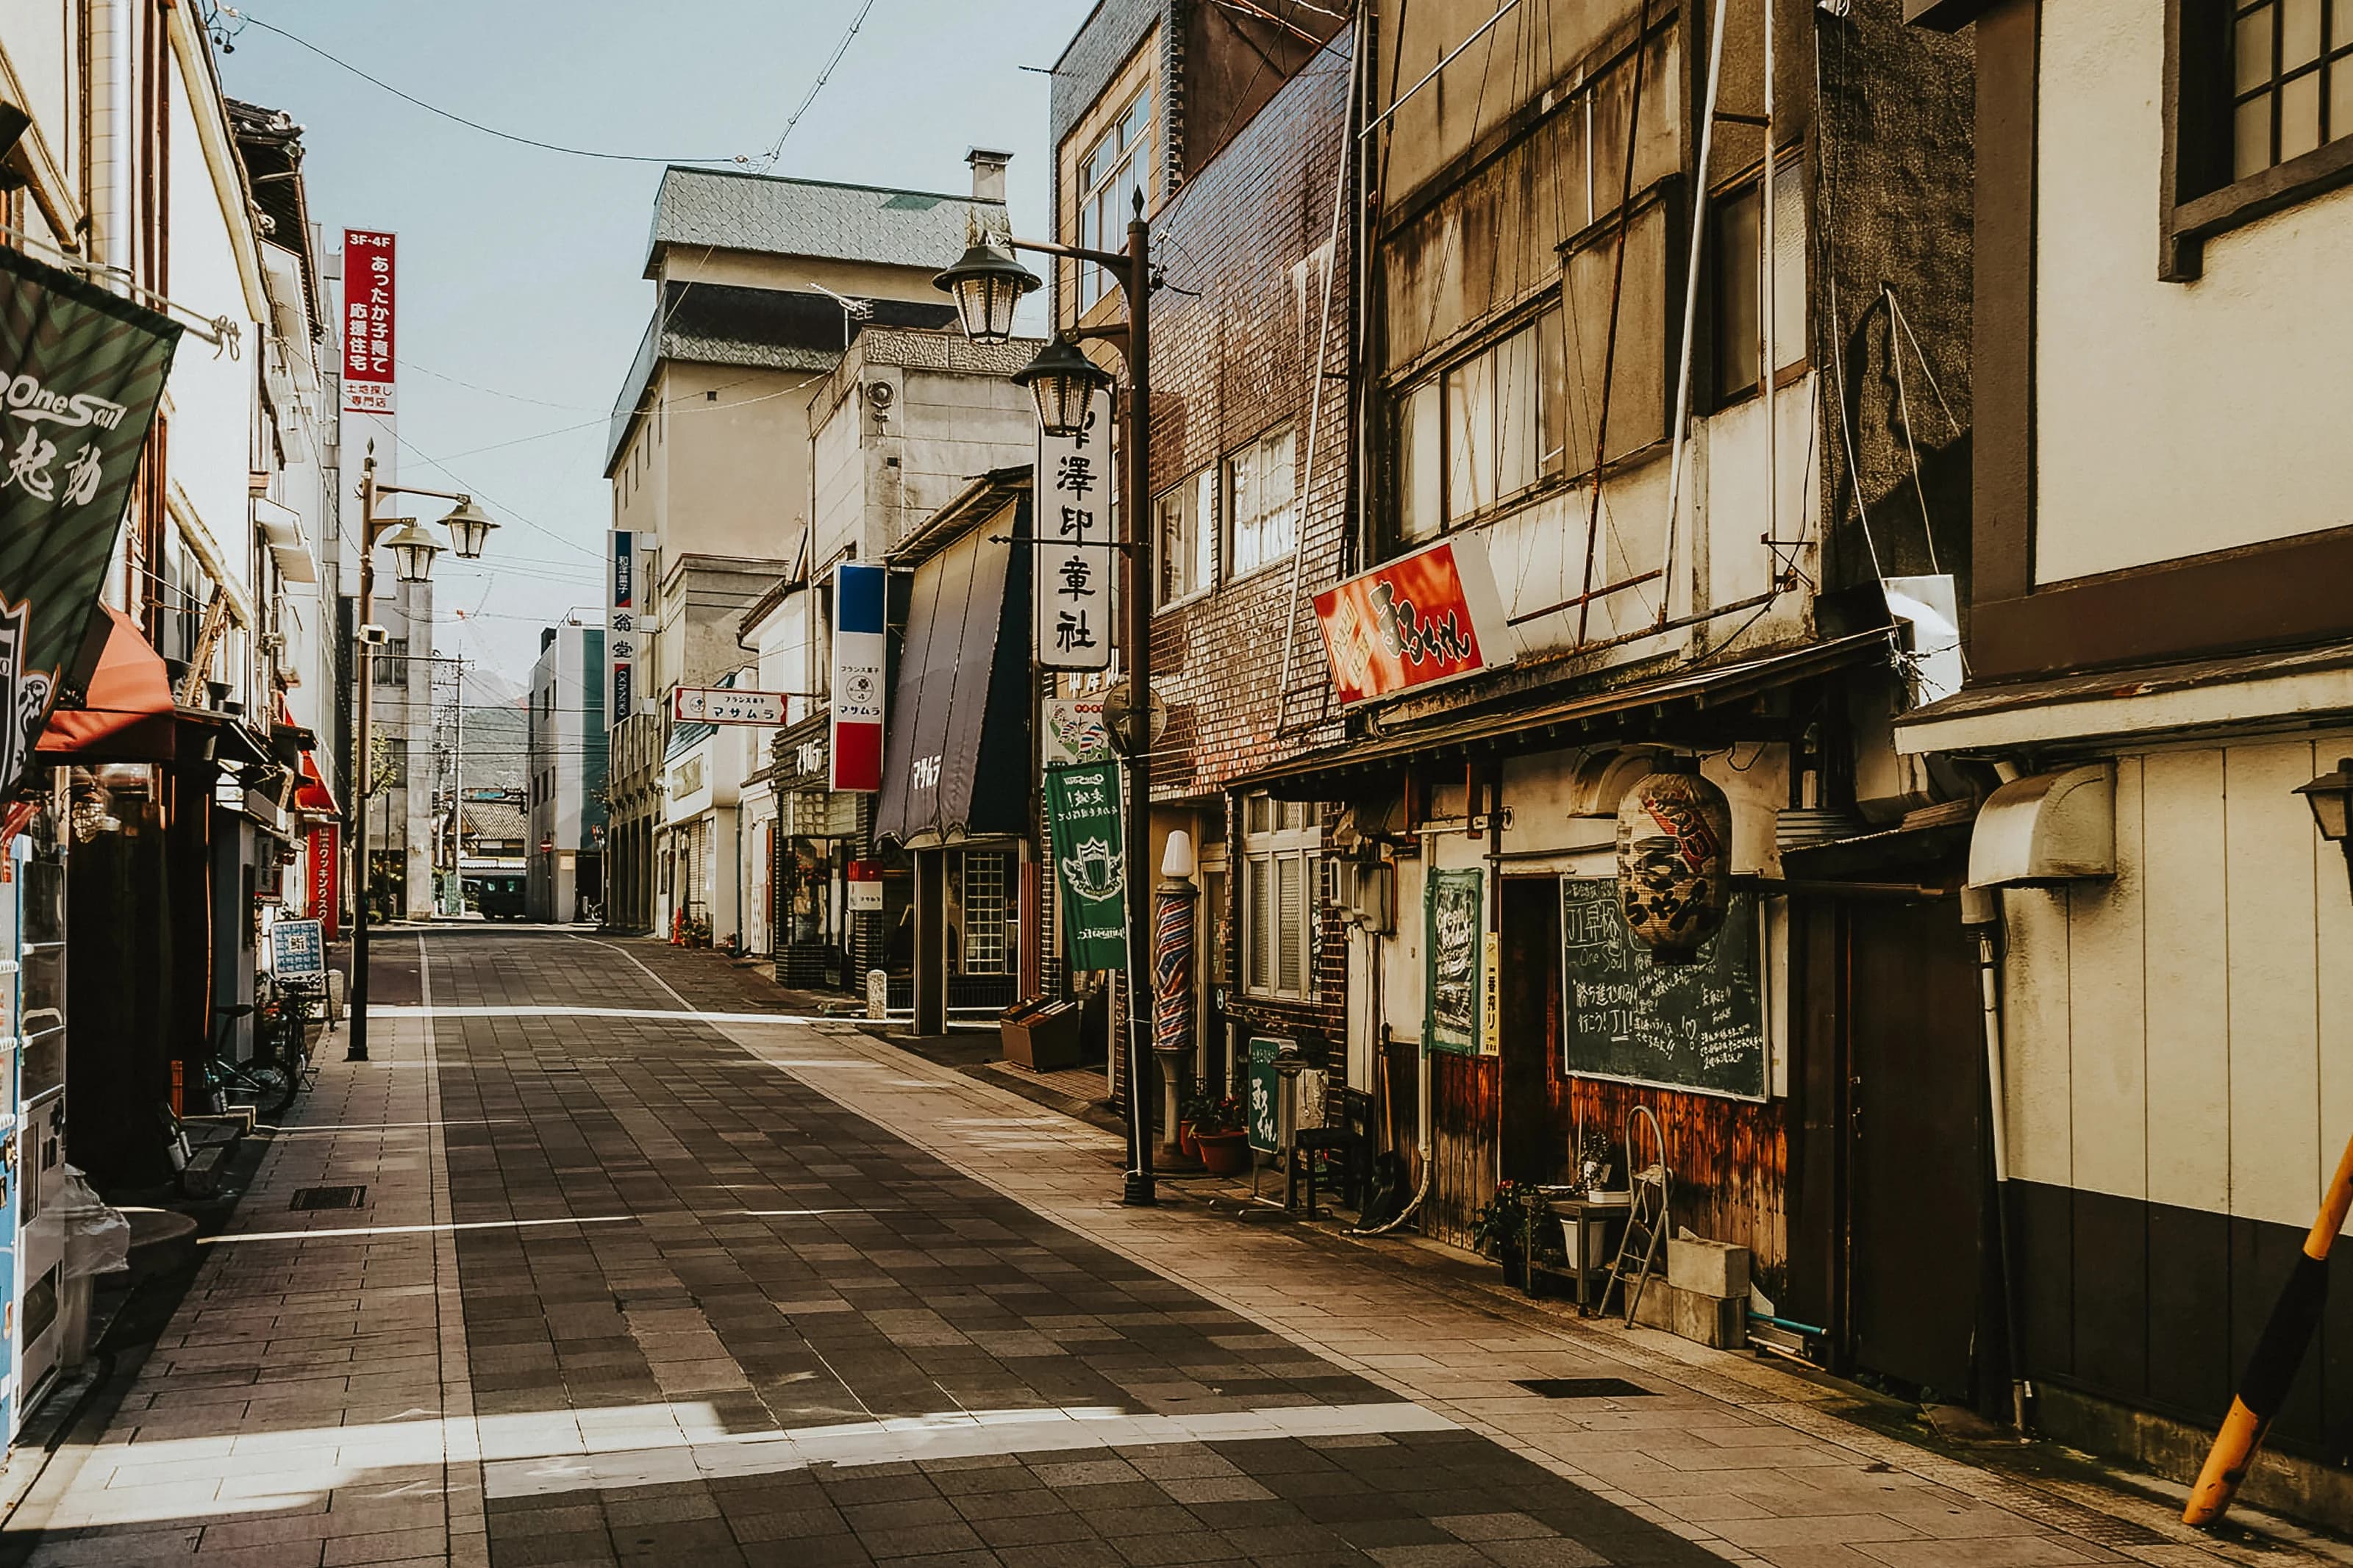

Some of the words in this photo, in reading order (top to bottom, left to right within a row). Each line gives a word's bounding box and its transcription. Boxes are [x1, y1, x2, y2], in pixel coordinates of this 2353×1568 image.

[349, 302, 368, 371] 応援住宅
[0, 426, 102, 507] 起動
[612, 612, 635, 659] 翁堂
[713, 706, 775, 720] マサムラ
[839, 704, 881, 716] マサムラ
